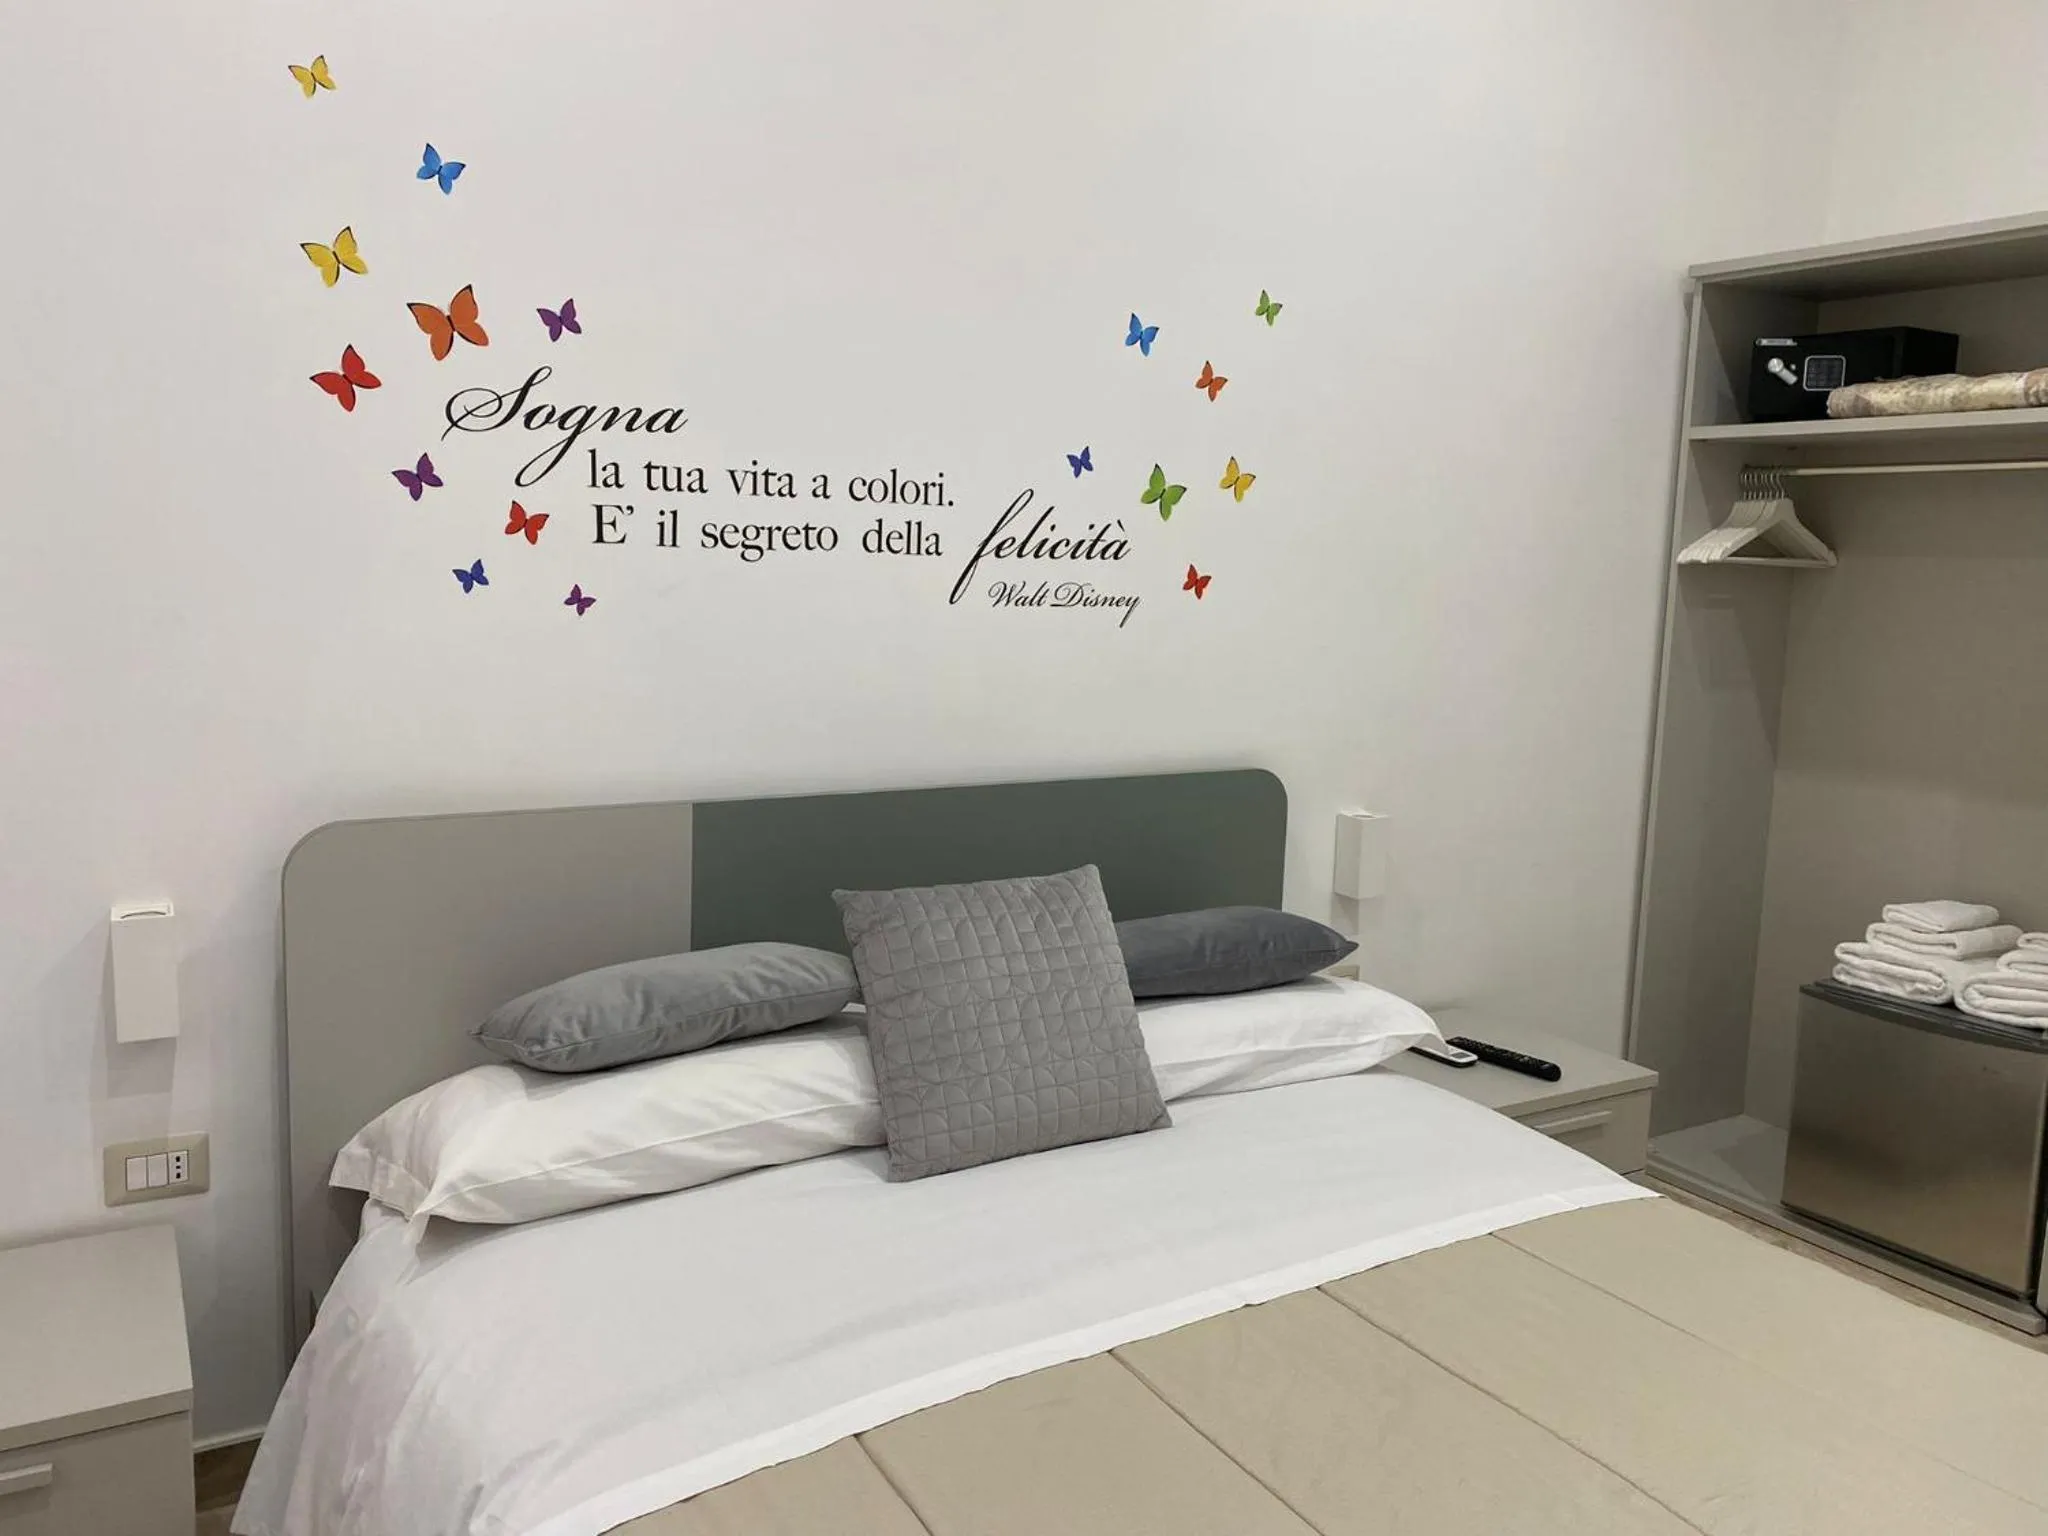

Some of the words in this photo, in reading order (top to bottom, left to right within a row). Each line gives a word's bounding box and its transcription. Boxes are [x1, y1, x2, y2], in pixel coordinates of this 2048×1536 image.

[441, 365, 689, 488] Sogna
[587, 449, 625, 489] la
[644, 459, 709, 494] tua
[726, 459, 797, 499] vita
[811, 474, 831, 500] a
[848, 468, 955, 507] colori.
[656, 509, 679, 548] il
[700, 519, 839, 563] segreto
[862, 519, 943, 557] della
[948, 488, 1133, 605] felicità
[987, 580, 1050, 609] Walt
[1051, 582, 1141, 629] Disney
